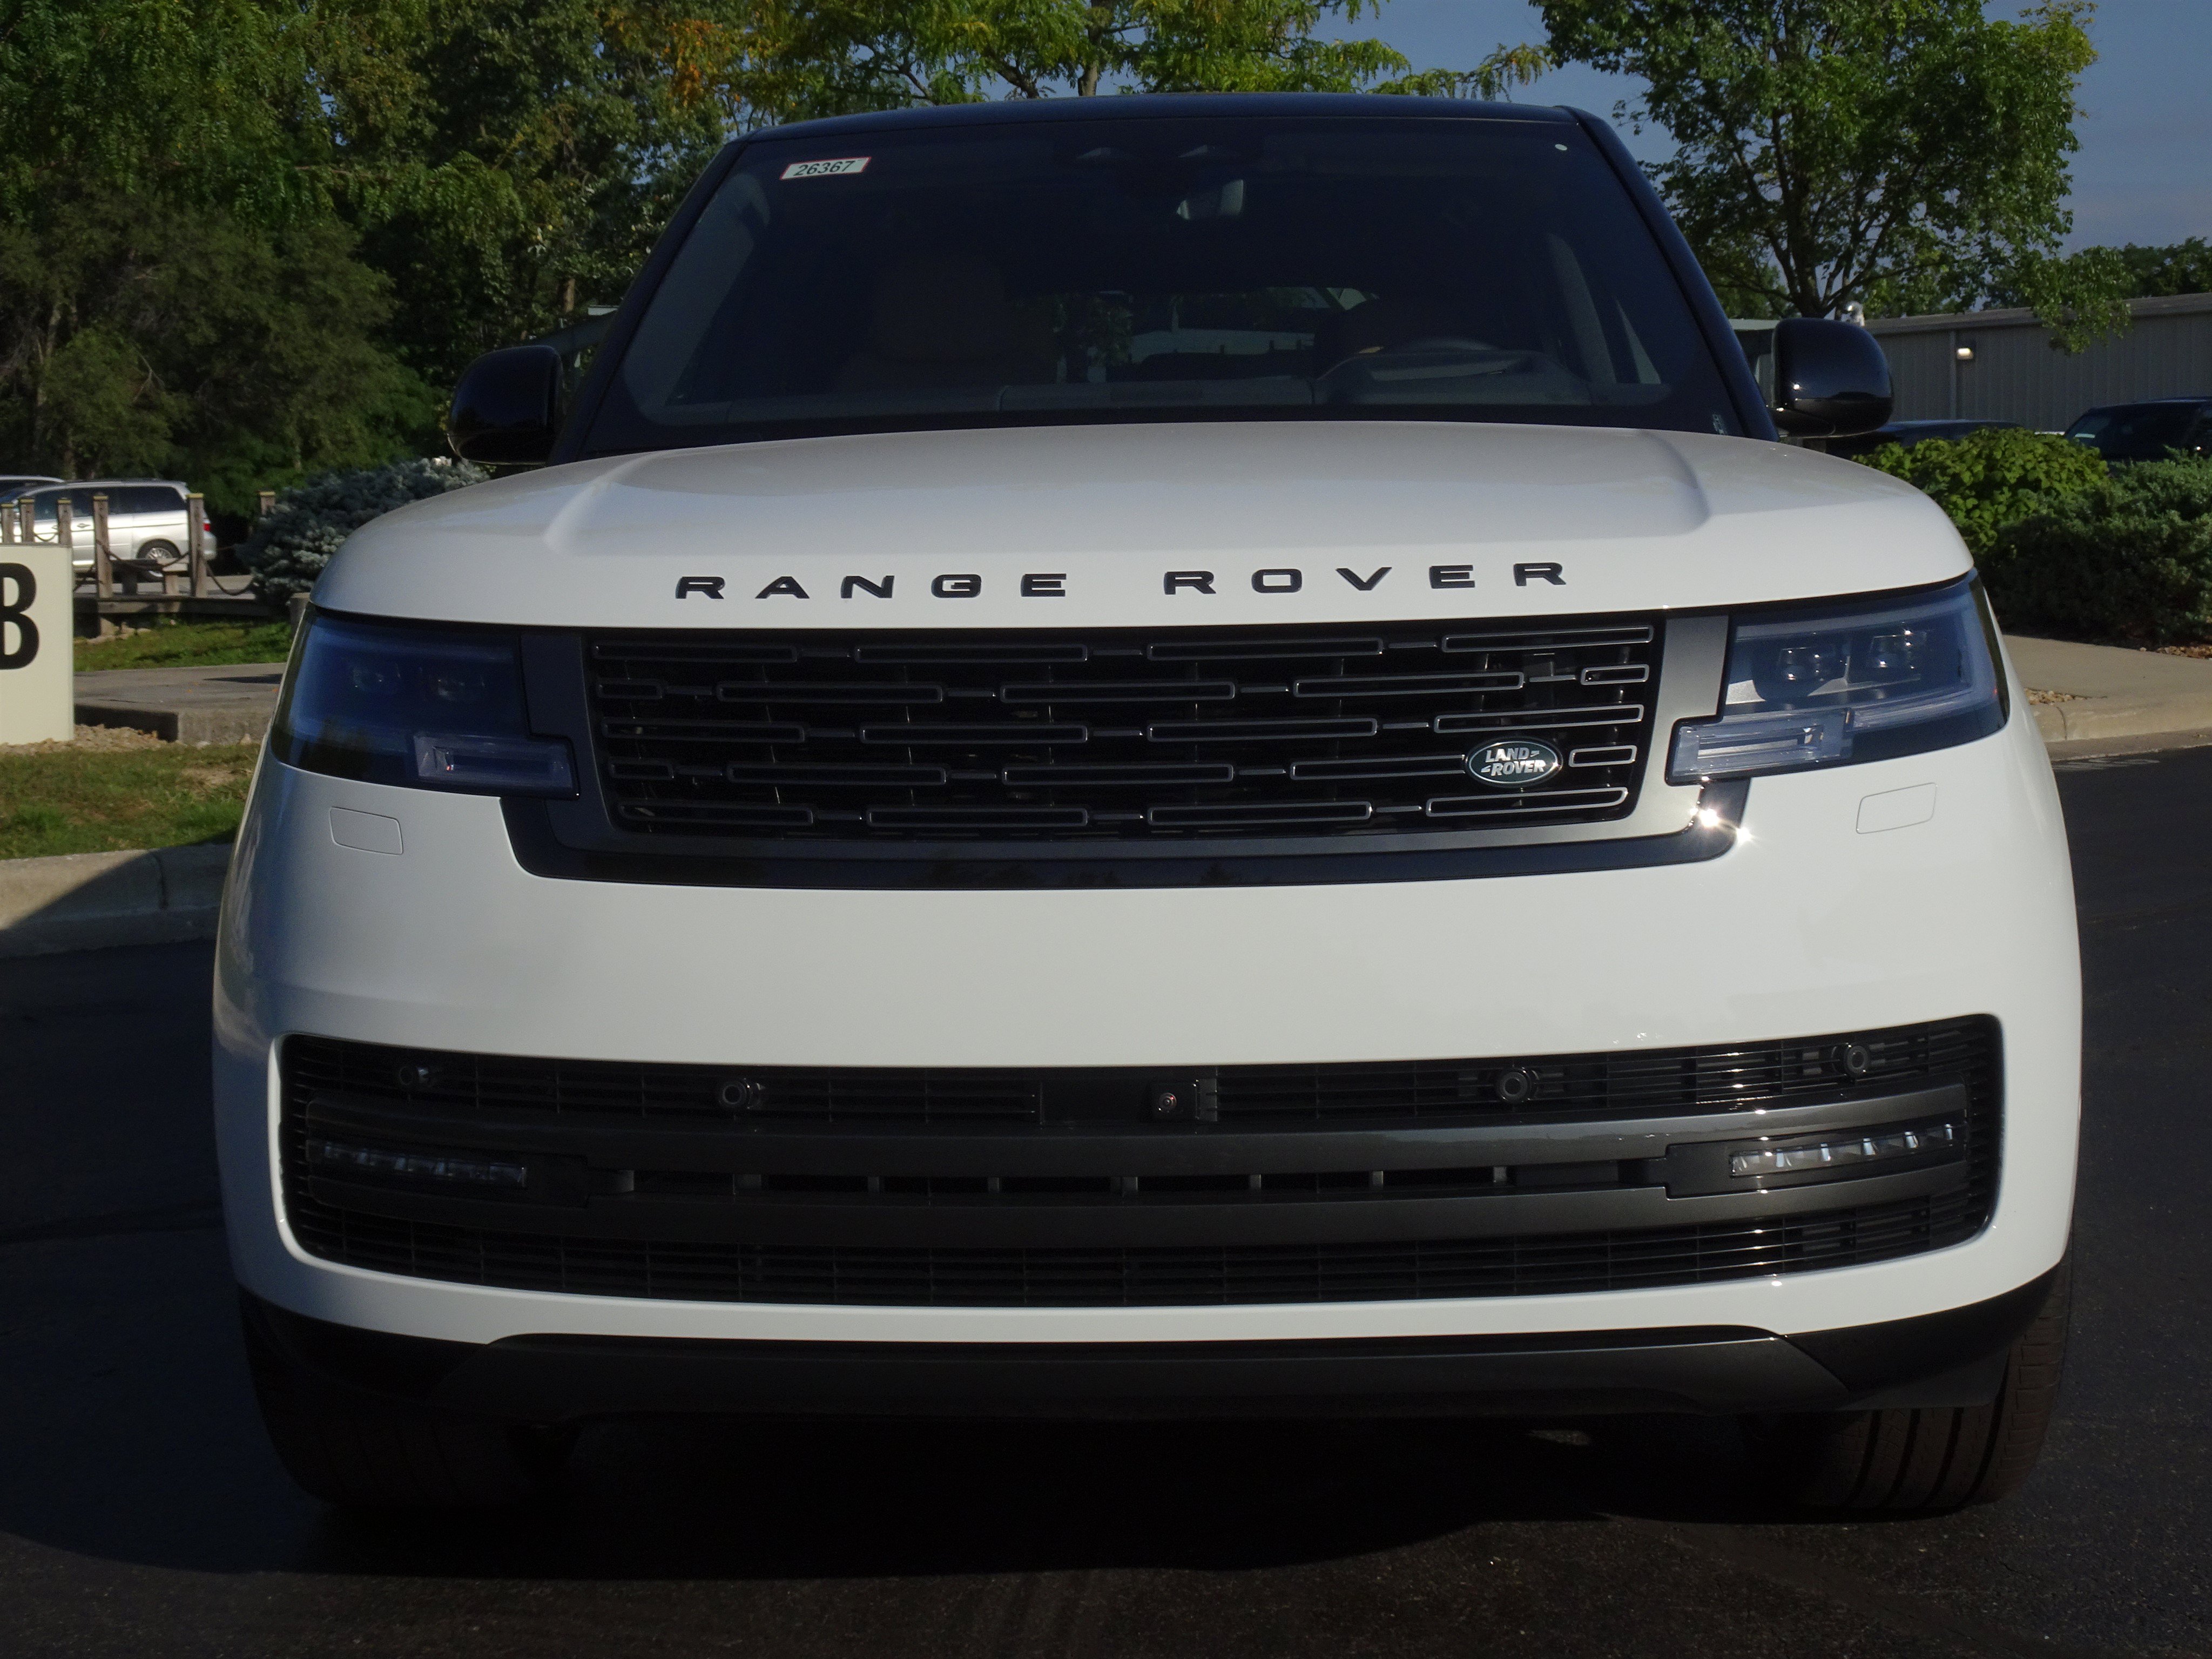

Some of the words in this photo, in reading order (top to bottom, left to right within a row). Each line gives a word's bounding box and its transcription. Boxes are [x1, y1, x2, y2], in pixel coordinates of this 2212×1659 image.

[793, 161, 855, 176] 26367
[676, 574, 1067, 599] RANGE
[1164, 562, 1567, 595] ROVER
[0, 562, 39, 670] B
[1486, 747, 1529, 763] LAND
[1491, 759, 1546, 776] ROVER
